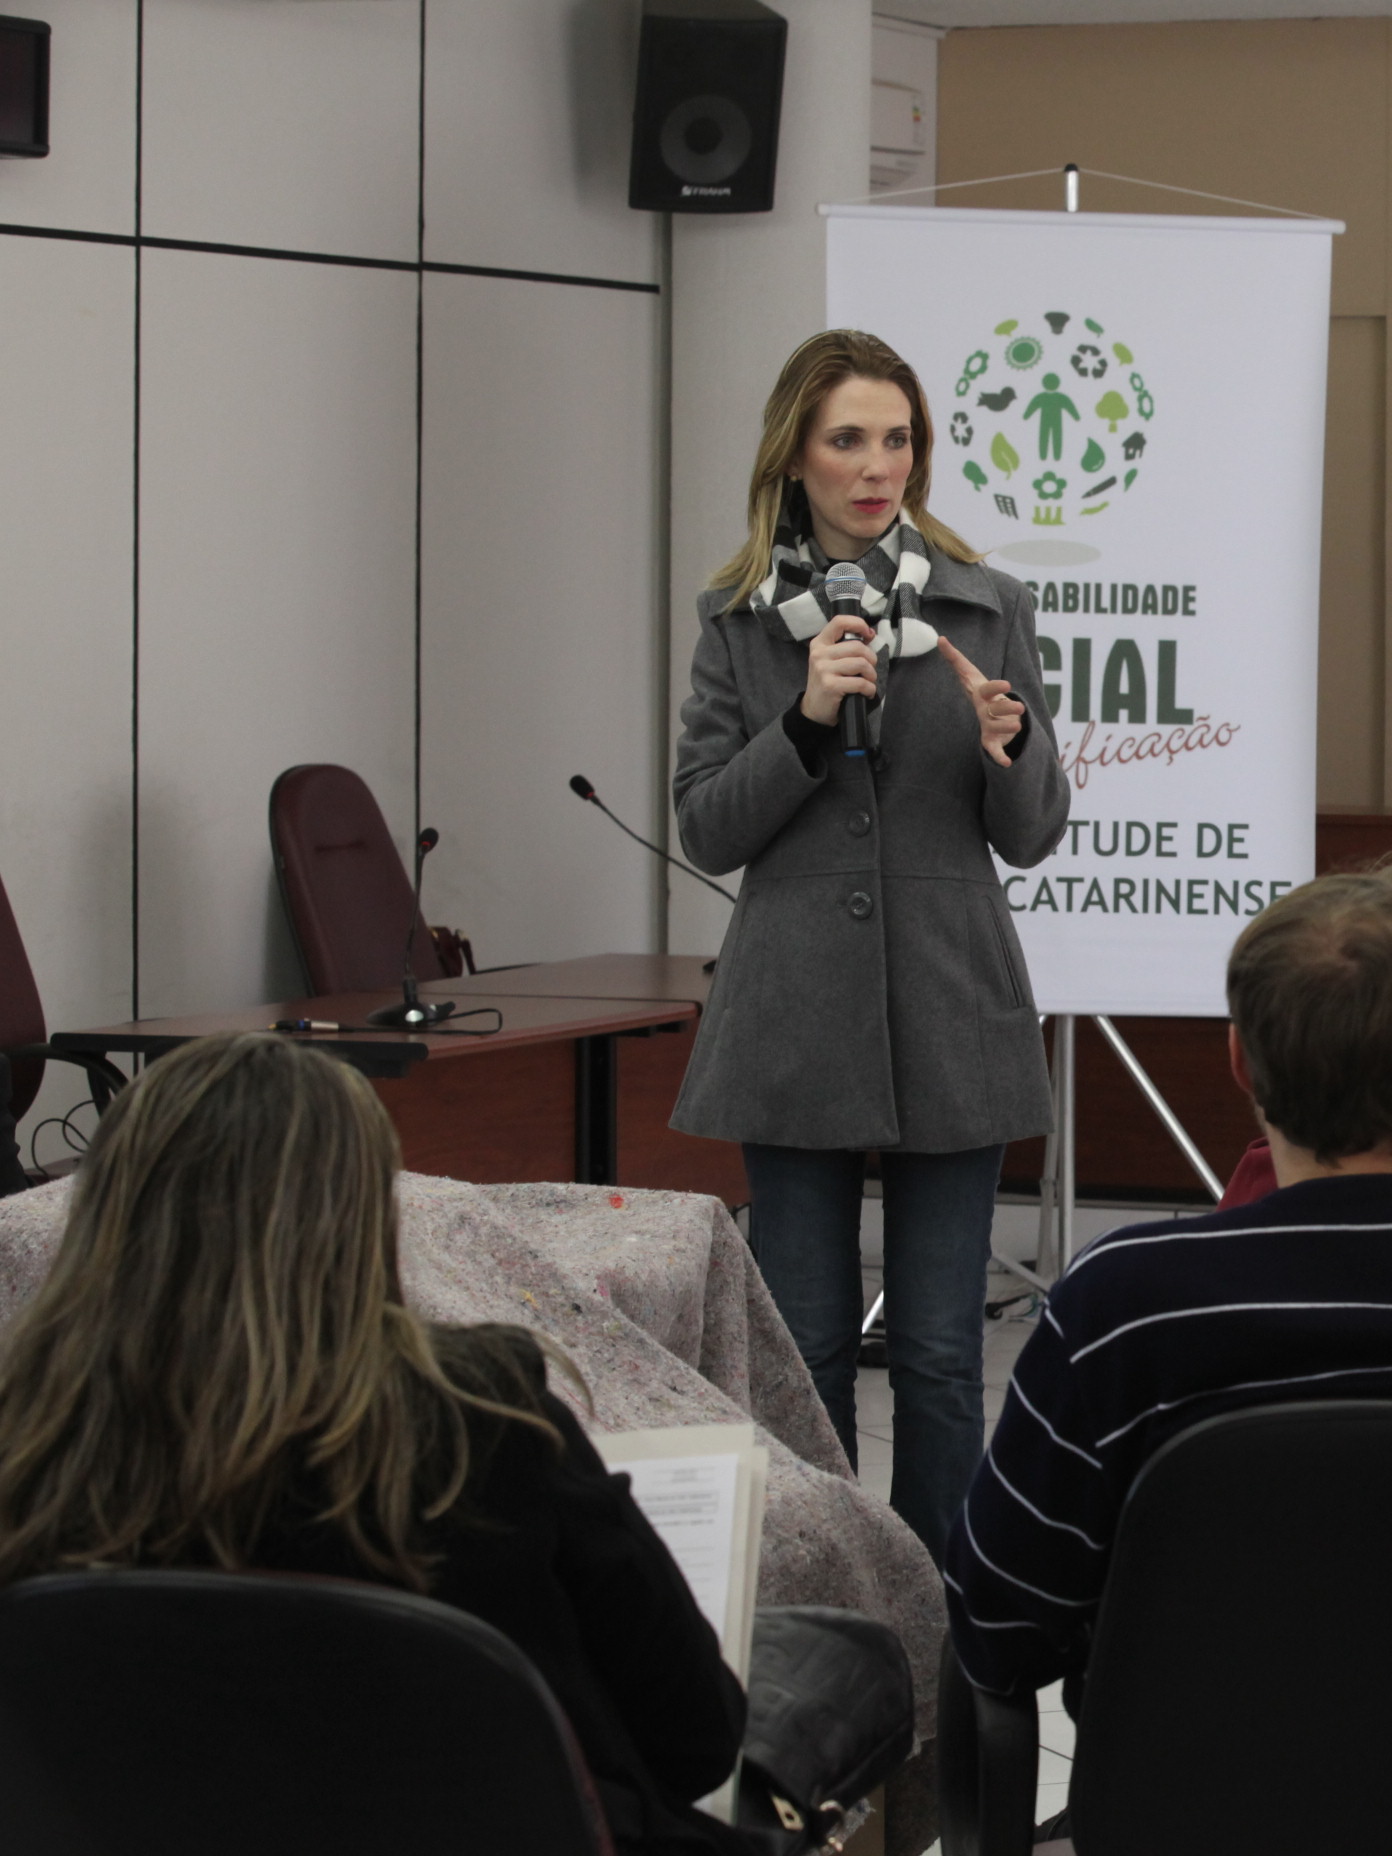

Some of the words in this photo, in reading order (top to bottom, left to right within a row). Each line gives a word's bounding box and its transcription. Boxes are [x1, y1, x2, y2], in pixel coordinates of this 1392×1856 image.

[1049, 820, 1179, 858] TUDE
[1196, 822, 1250, 859] DE
[1003, 876, 1292, 916] CATARINENSE
